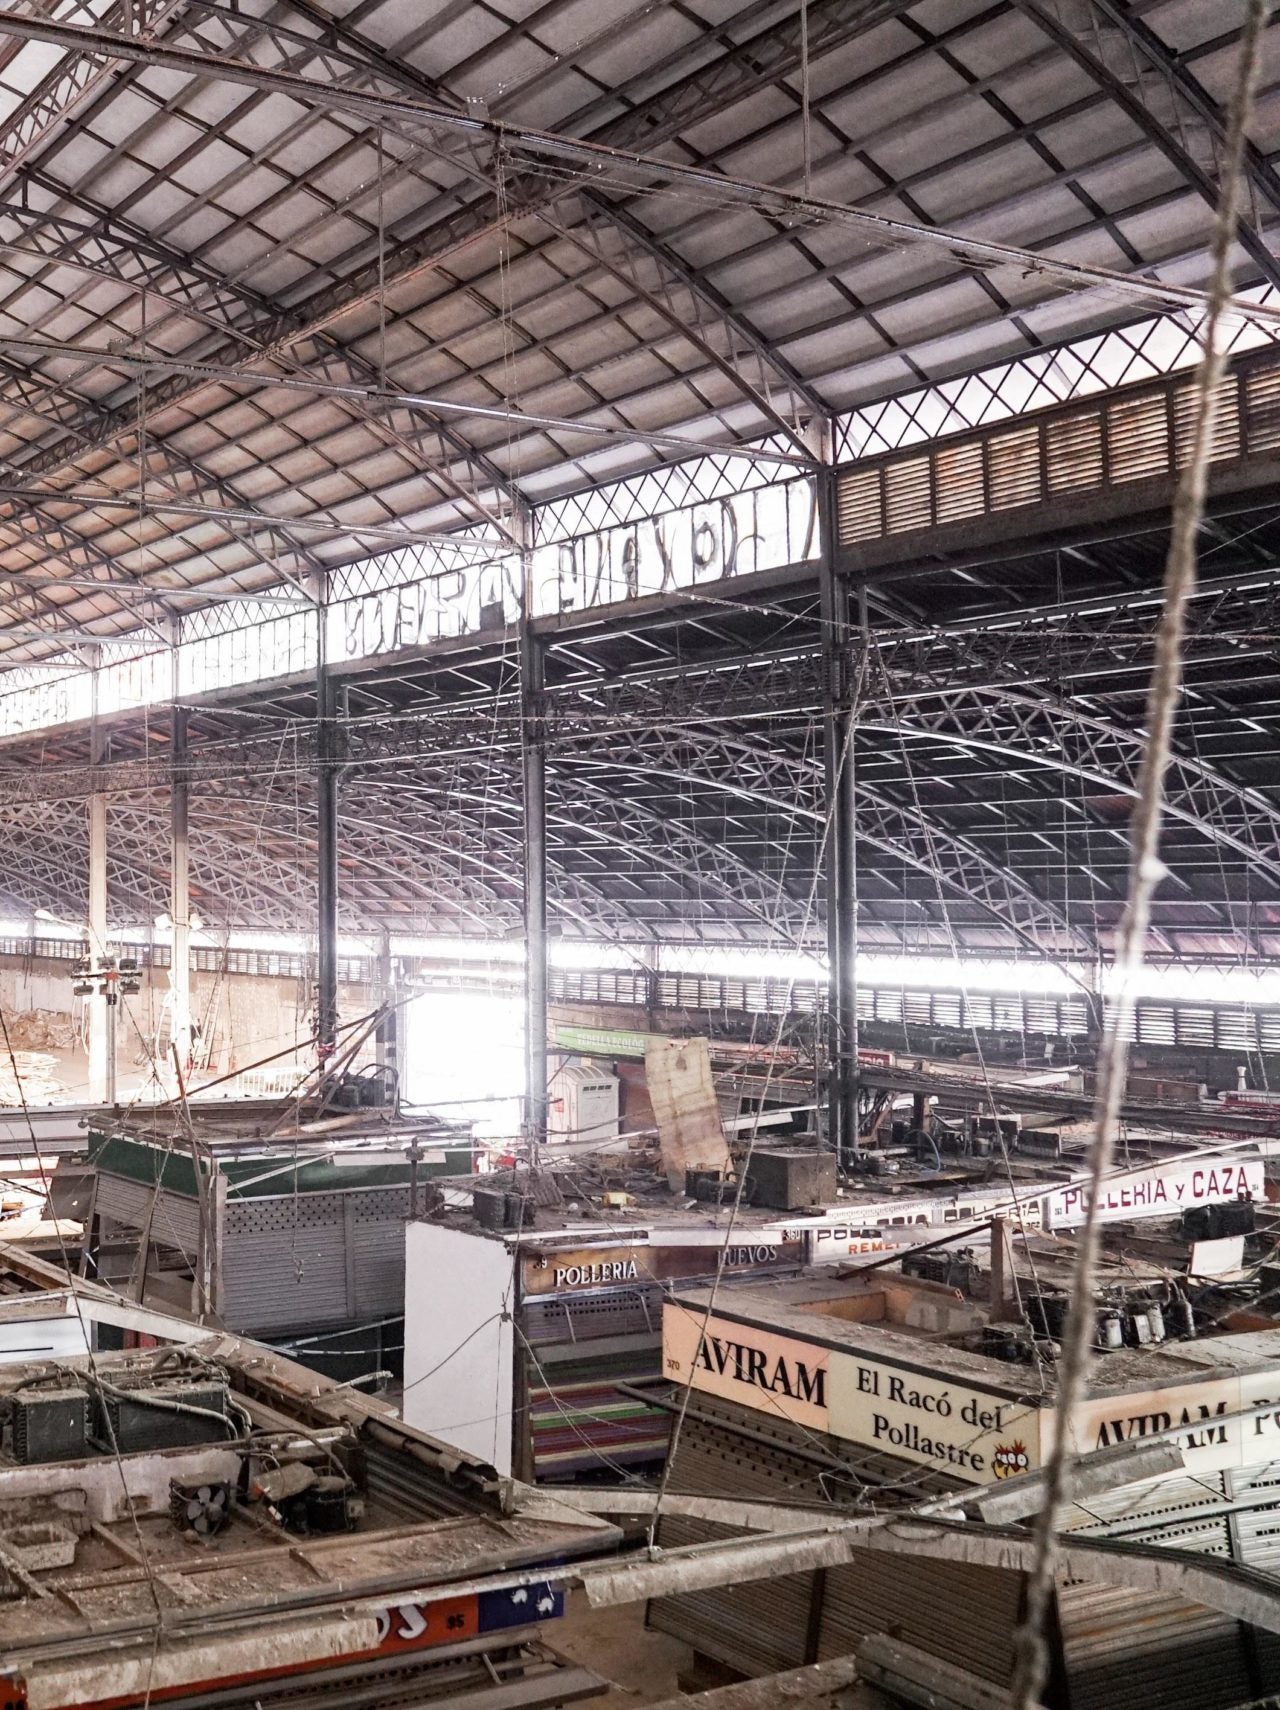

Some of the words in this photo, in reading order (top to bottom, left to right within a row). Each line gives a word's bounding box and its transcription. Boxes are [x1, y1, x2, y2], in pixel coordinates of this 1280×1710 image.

[1193, 1166, 1248, 1198] CAZA
[555, 1260, 638, 1288] POLLERIA
[691, 1336, 828, 1409] AVIRAM
[856, 1367, 880, 1396] El
[888, 1375, 952, 1418] Racó
[961, 1398, 1003, 1433] del
[872, 1413, 985, 1472] Pollastre
